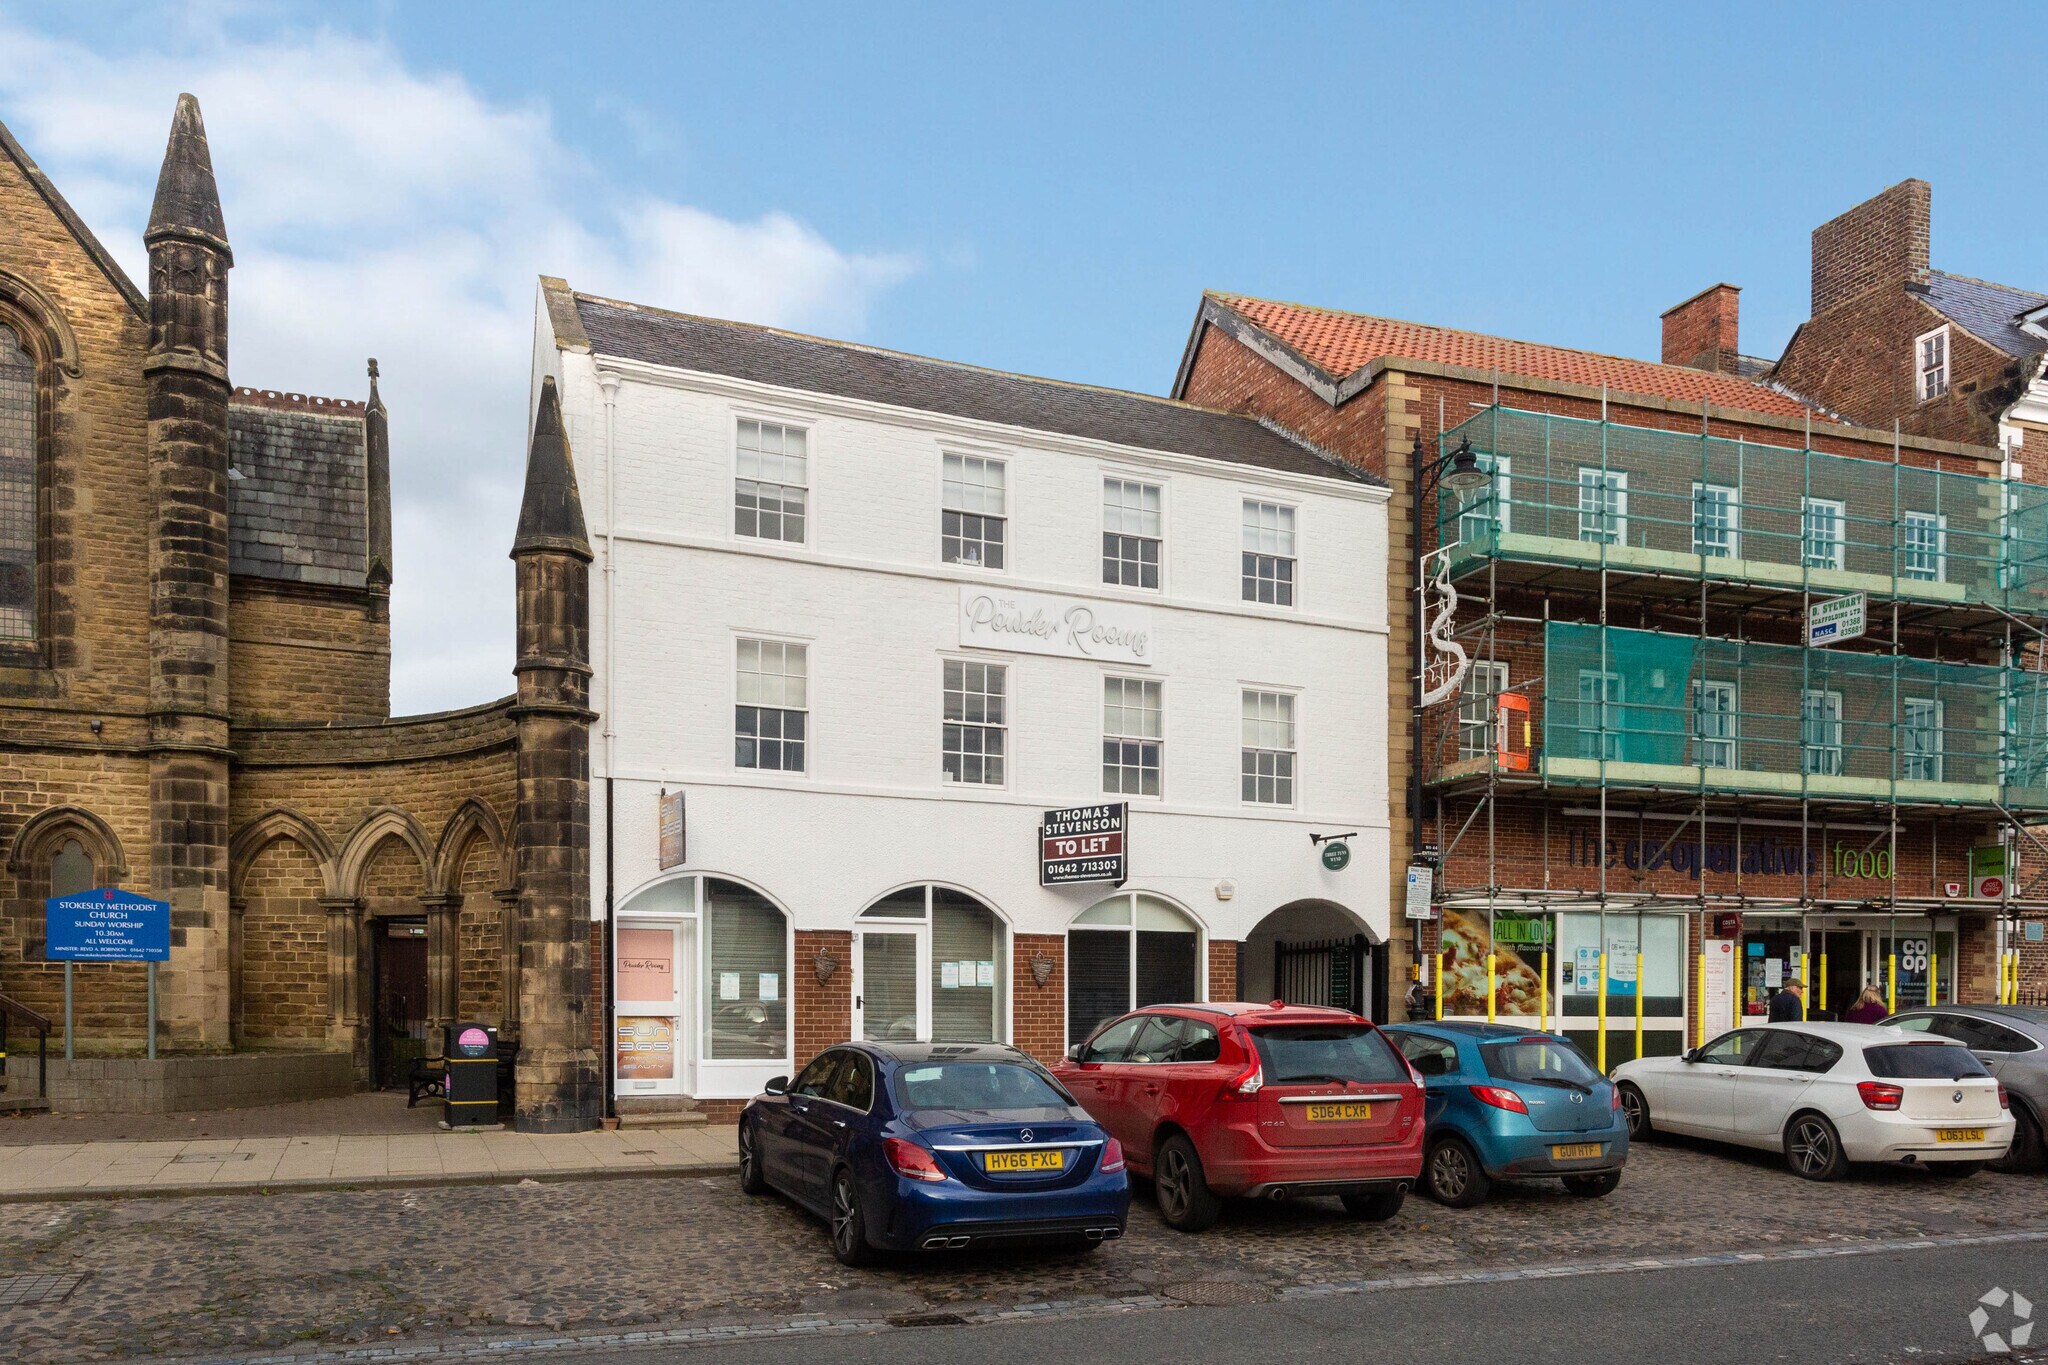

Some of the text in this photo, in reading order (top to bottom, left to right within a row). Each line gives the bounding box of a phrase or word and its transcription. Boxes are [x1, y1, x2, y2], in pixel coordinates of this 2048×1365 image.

[998, 599, 1016, 609] THE
[1822, 595, 1862, 614] STEWART
[965, 595, 1149, 657] Powder Rooms
[1811, 611, 1848, 626] SCAFFOLDING
[1814, 627, 1833, 637] NASC
[1055, 806, 1110, 822] THOMAS
[1045, 817, 1120, 835] STEVENSON
[1055, 836, 1110, 856] TO LET
[1565, 826, 1617, 869] The
[1834, 840, 1893, 878] food
[1047, 860, 1117, 875] 01642 713303
[59, 901, 158, 911] STOKESLEY METHODIST
[89, 911, 128, 919] CHURCH
[74, 920, 106, 928] SUNDAY
[1493, 921, 1512, 940] FALL
[1516, 922, 1526, 940] IN
[617, 1041, 670, 1051] 365
[1311, 1105, 1367, 1119] SD64 CXR
[1965, 1130, 1982, 1140] LSL
[1578, 1144, 1595, 1157] HTF
[991, 1152, 1058, 1169] HY66 FXC
